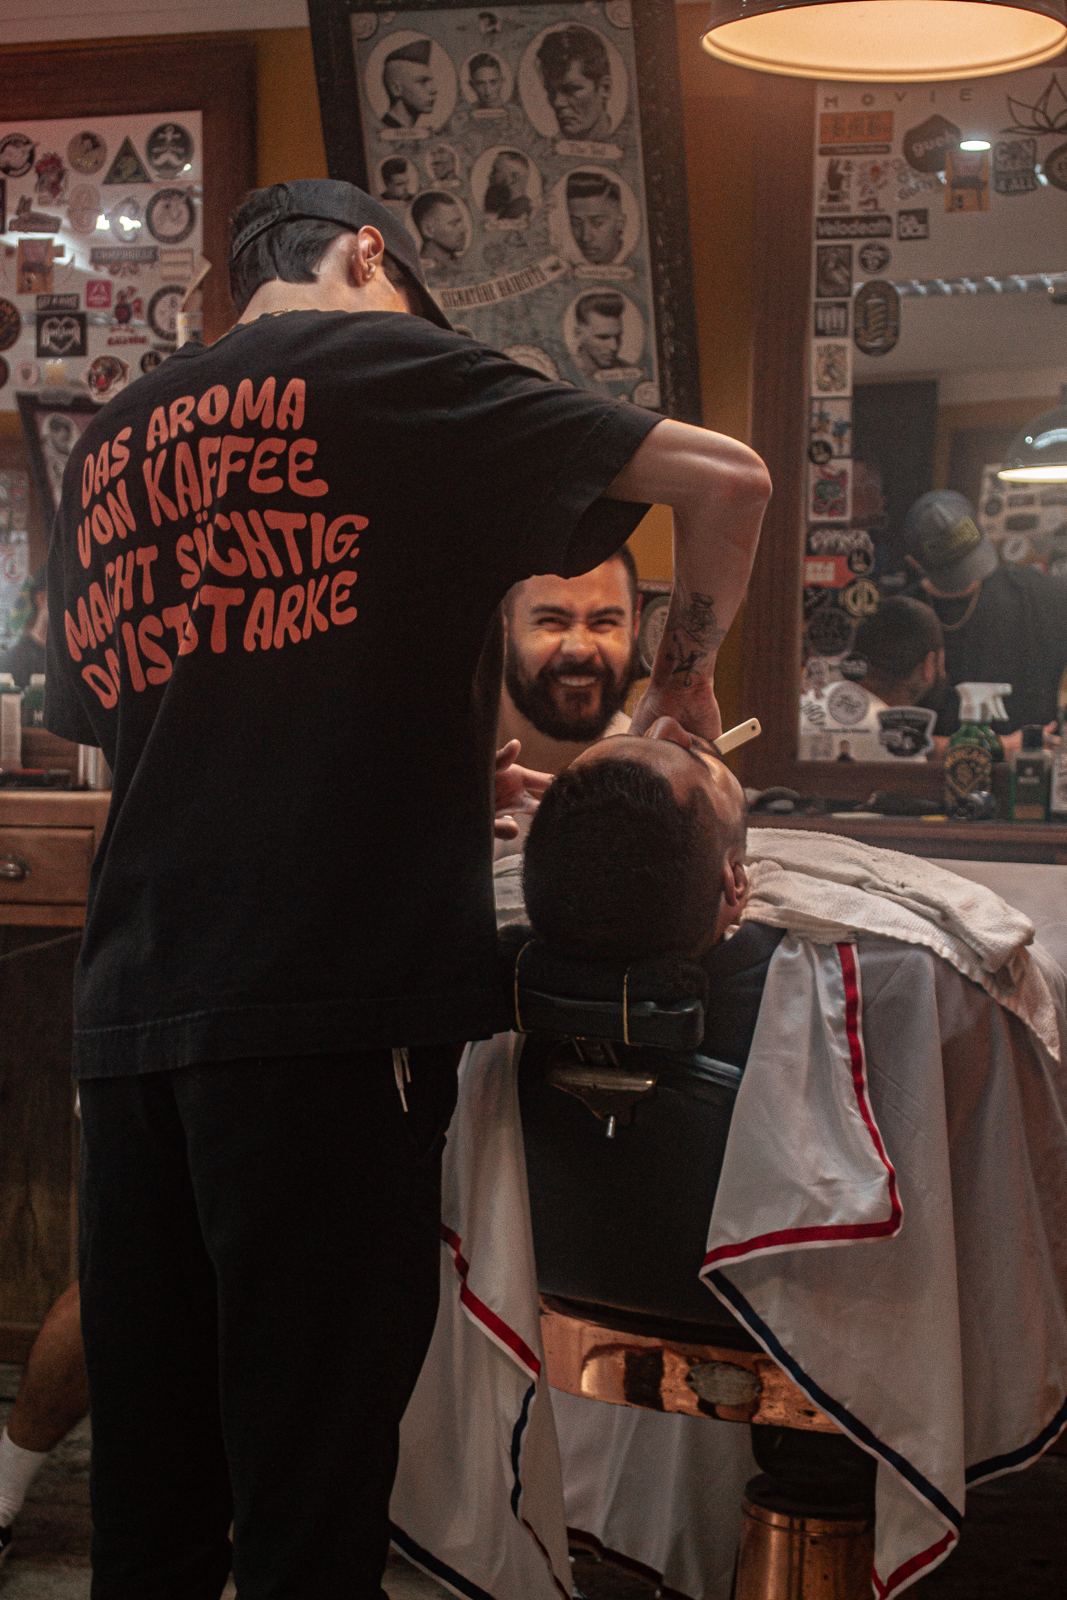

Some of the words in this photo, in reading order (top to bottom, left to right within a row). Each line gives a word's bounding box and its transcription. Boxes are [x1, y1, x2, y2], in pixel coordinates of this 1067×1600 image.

[441, 283, 499, 309] SIGNATURE
[497, 264, 548, 299] HAIRCUTS
[77, 479, 136, 569] VON
[143, 435, 329, 527] KAFFEE
[82, 426, 132, 509] DAS
[146, 376, 306, 451] AROMA
[64, 545, 158, 662] MACHT
